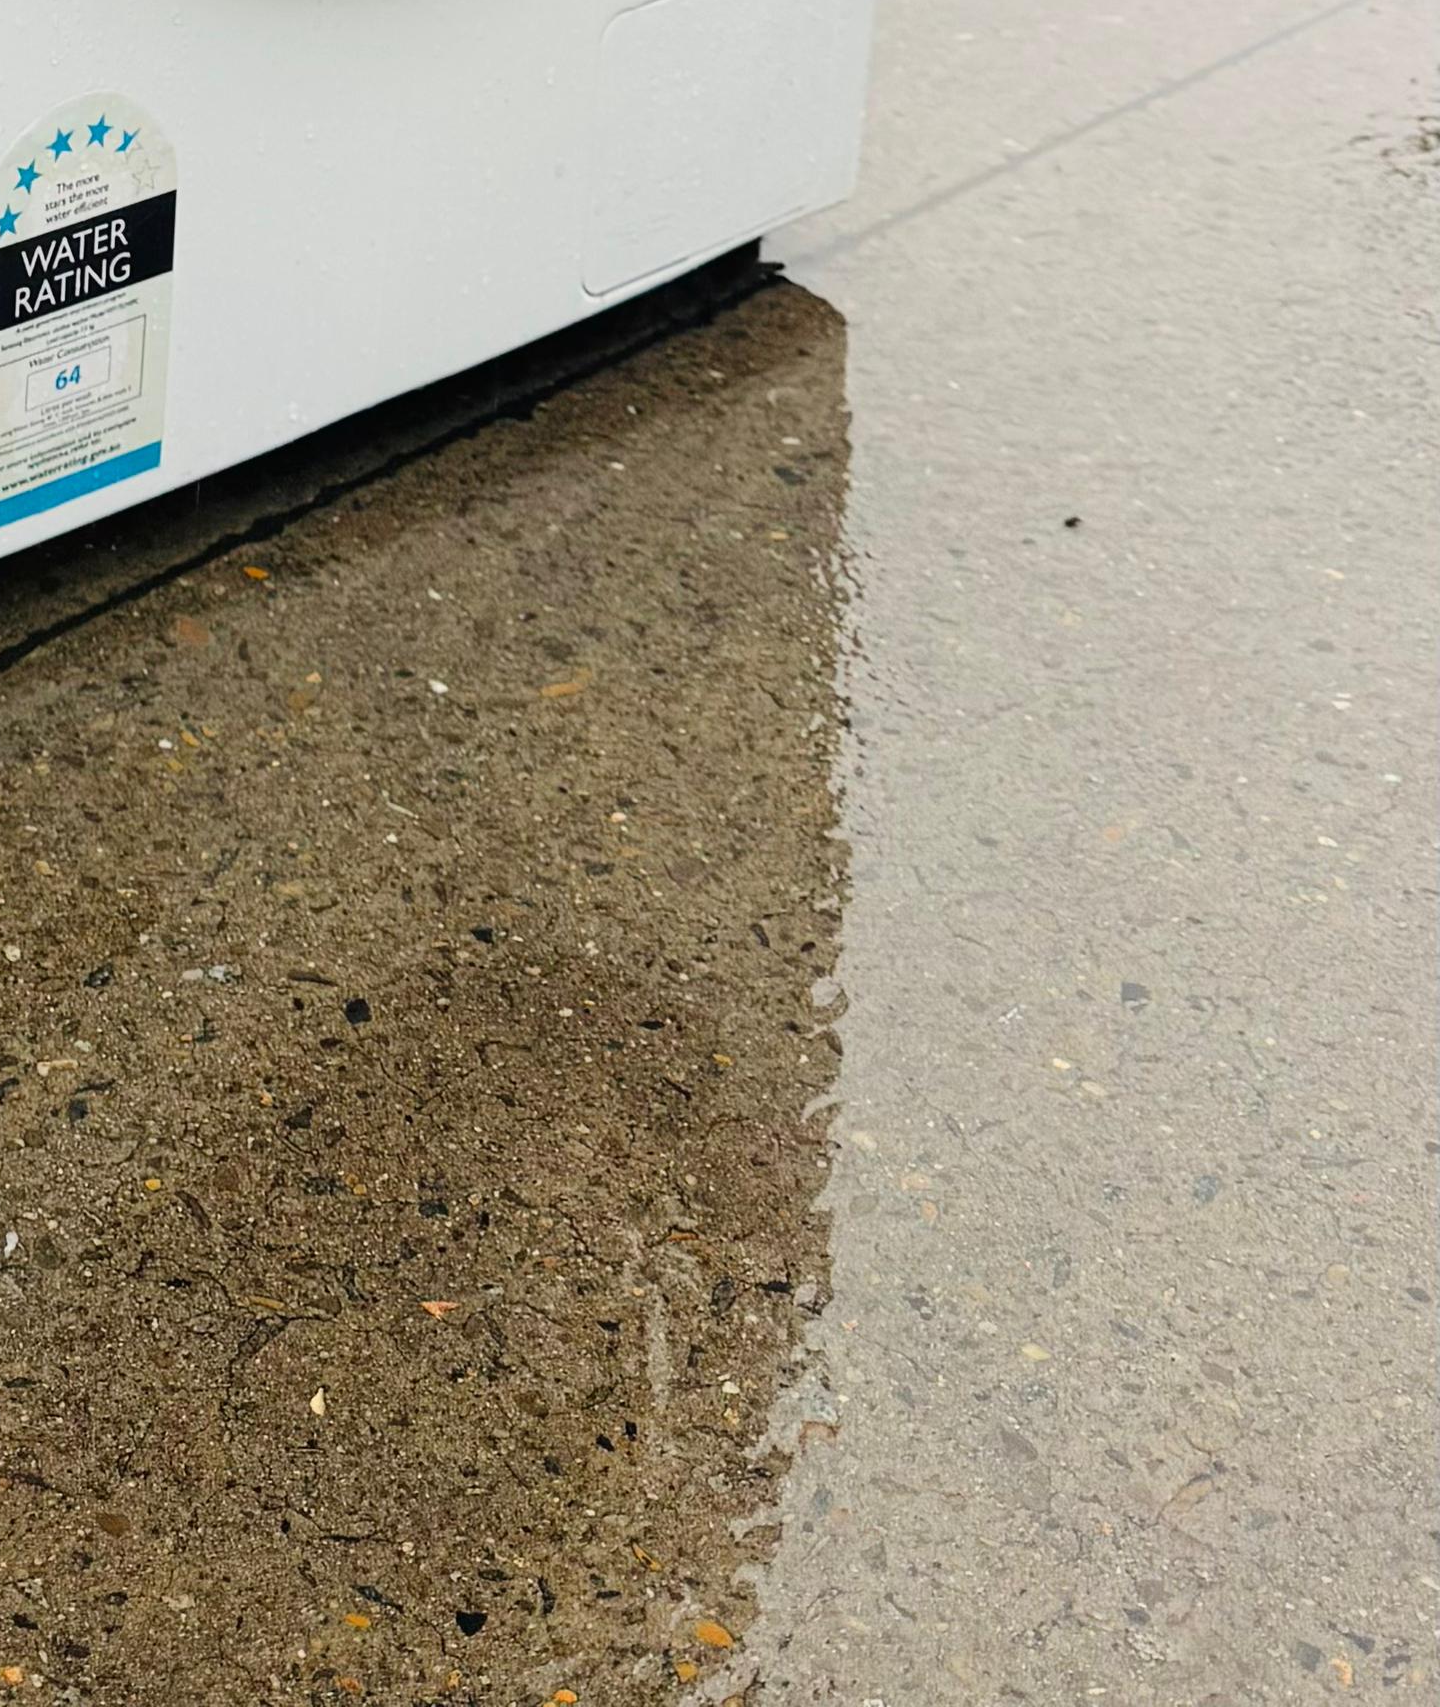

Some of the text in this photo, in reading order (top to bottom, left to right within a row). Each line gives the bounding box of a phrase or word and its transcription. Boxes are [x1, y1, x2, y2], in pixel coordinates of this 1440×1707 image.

[57, 174, 100, 193] The more
[45, 184, 109, 211] stars the more
[46, 197, 109, 224] water efficient
[21, 218, 128, 278] WATER
[15, 252, 131, 318] RATING
[55, 364, 81, 390] 64
